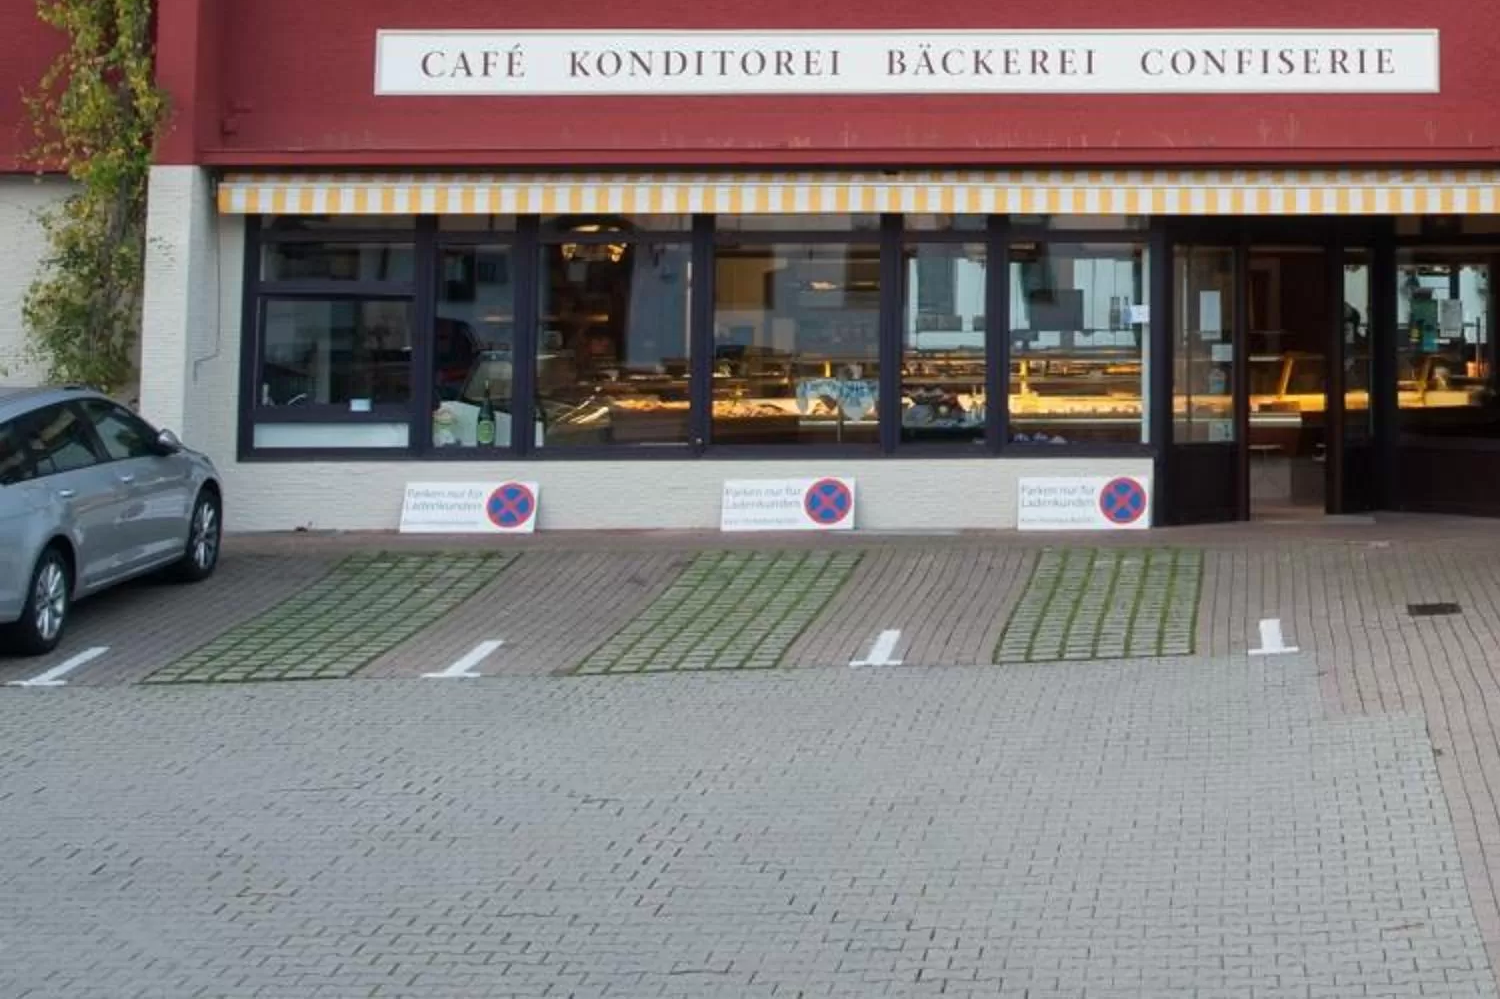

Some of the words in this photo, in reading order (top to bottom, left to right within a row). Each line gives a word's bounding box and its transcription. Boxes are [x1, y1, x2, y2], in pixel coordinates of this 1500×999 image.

[421, 43, 527, 78] CAFÉ
[568, 49, 841, 77] KONDITOREI
[886, 43, 1096, 76] BÄCKEREI
[1140, 47, 1396, 76] CONFISERIE
